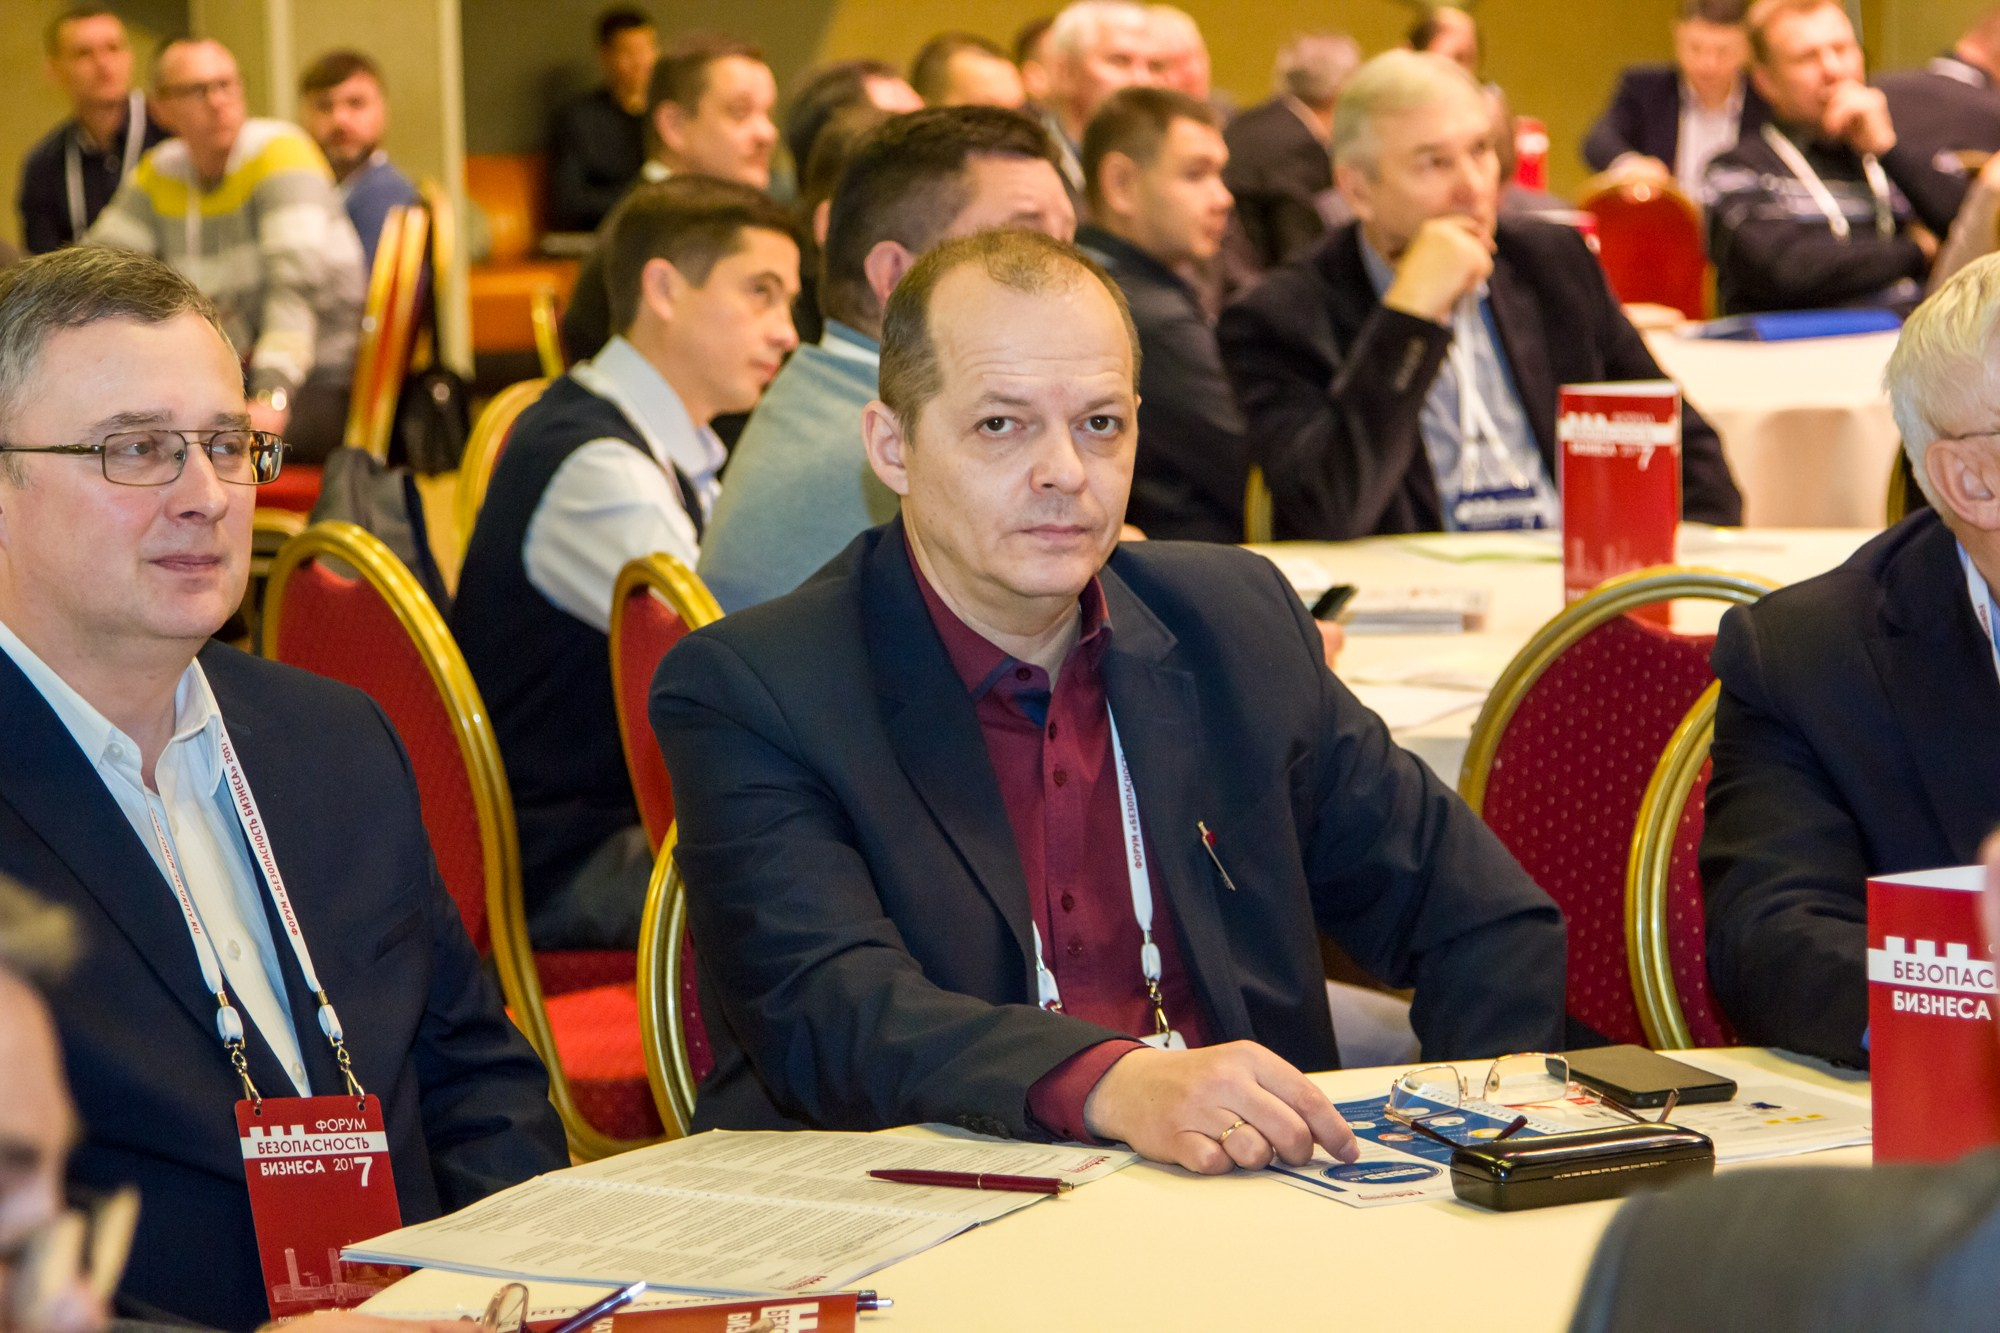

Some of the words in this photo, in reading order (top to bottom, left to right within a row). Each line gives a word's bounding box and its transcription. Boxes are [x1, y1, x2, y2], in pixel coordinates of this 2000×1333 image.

[230, 765, 254, 817] БИЗНЕСА»
[248, 818, 285, 898] «БЕЗОПАСНОСТЬ
[1130, 834, 1143, 869] ФОРУМ
[281, 901, 298, 936] ФОРУМ
[1893, 959, 1994, 989] БЕЗОПАС
[1892, 990, 1992, 1020] БИЗНЕСА
[315, 1117, 367, 1132] ФОРУМ
[257, 1137, 370, 1155] БЕЗОПАСНОСТЬ
[260, 1159, 326, 1177] БИЗНЕСА
[333, 1156, 373, 1187] 2017
